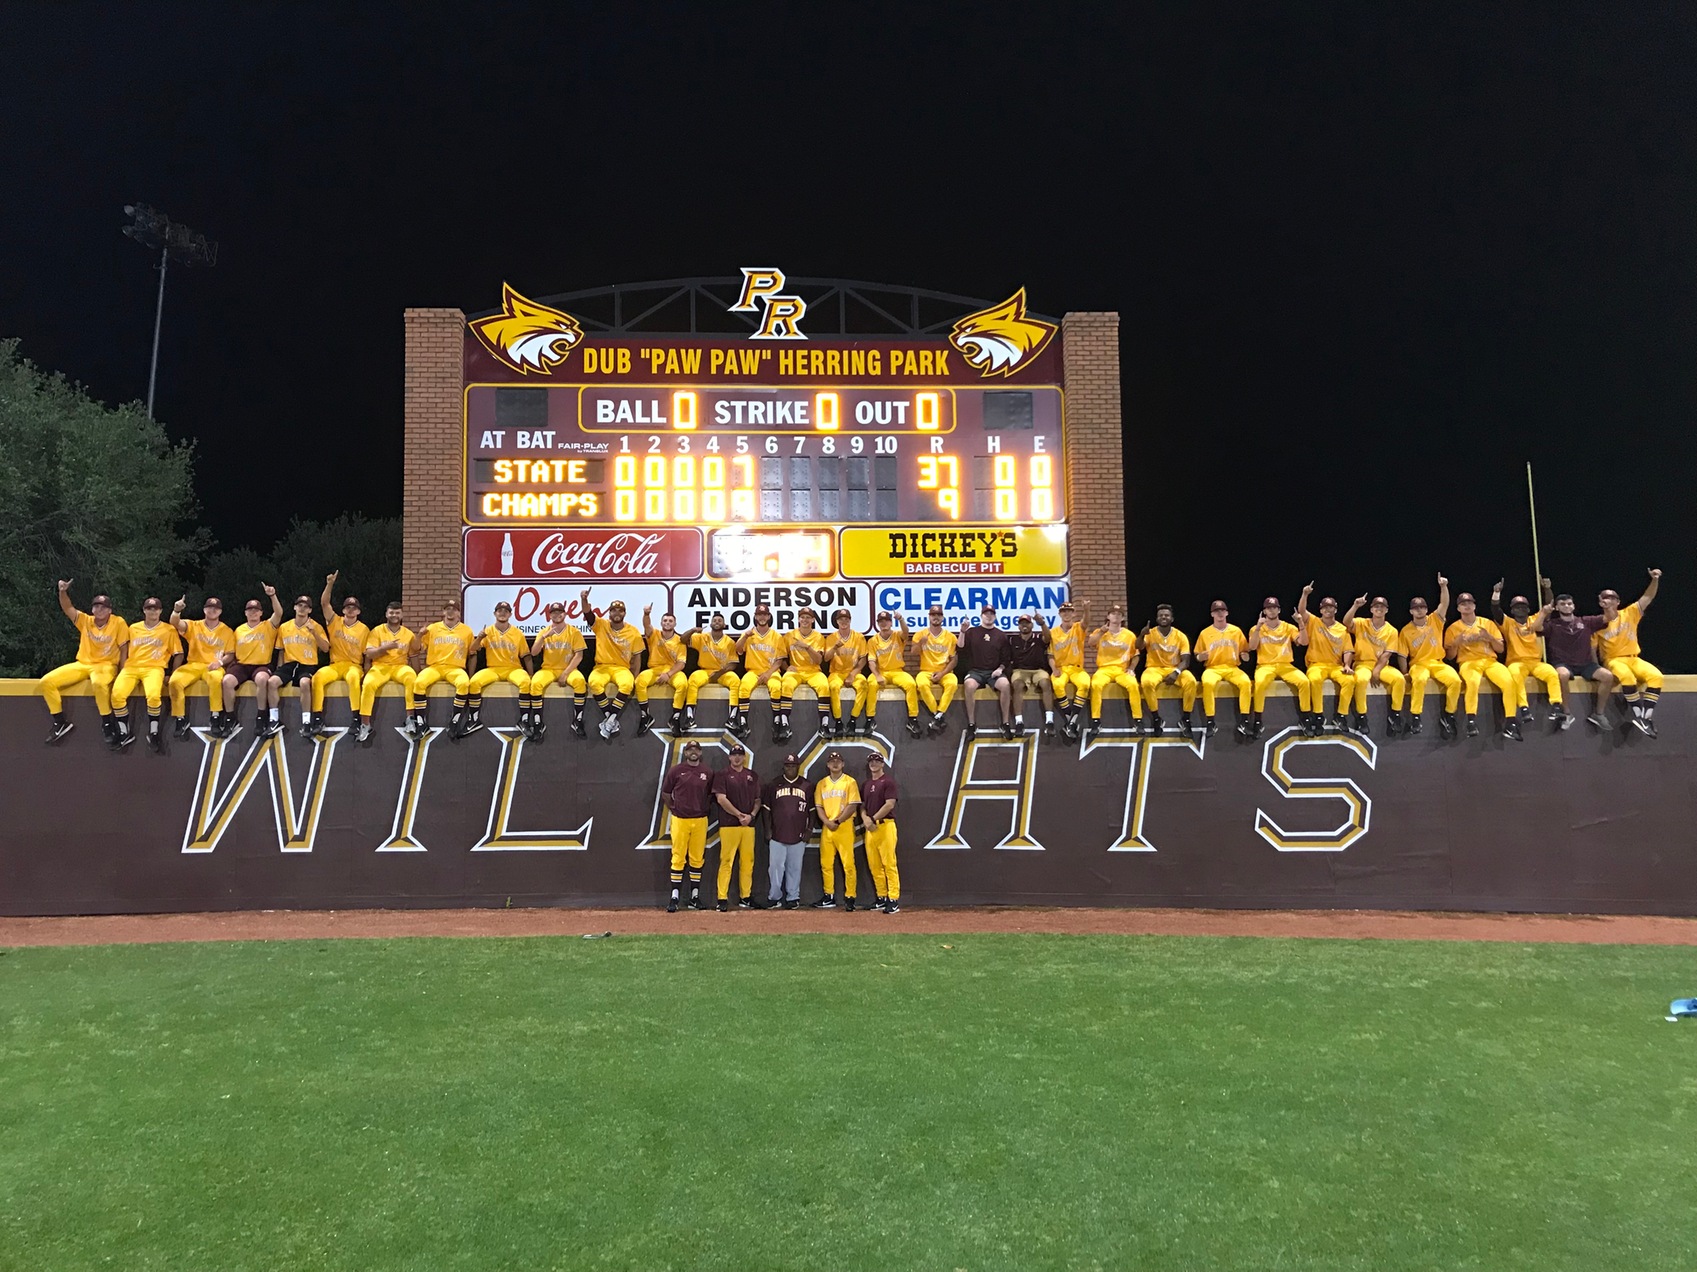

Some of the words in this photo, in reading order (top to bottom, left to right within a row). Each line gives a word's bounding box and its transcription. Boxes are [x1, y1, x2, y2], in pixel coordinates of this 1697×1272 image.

[583, 347, 631, 374] DUB
[641, 347, 702, 374] "PAW
[710, 348, 771, 375] PAW"
[779, 349, 881, 375] HERRING
[890, 350, 950, 376] PARK
[596, 399, 667, 423] BALL
[672, 391, 697, 429] 0
[714, 400, 810, 424] STRIKE
[815, 392, 839, 430] 0
[855, 400, 910, 425] OUT
[915, 392, 939, 430] 0
[479, 430, 505, 449] AT
[516, 430, 556, 449] BAT
[620, 435, 631, 454] 1
[647, 435, 661, 454] 2
[677, 435, 691, 454] 3
[706, 436, 720, 454] 4
[736, 436, 749, 454] 5
[764, 436, 778, 454] 6
[793, 436, 806, 454] 7
[822, 436, 836, 454] 8
[850, 436, 864, 454] 9
[874, 436, 898, 454] 10
[930, 436, 944, 454] R
[987, 435, 1001, 453] H
[1034, 435, 1046, 453] E
[493, 459, 588, 484] STATE
[615, 455, 637, 488] 0
[644, 455, 666, 488] 0
[673, 455, 696, 488] 0
[702, 455, 725, 488] 0
[917, 455, 960, 488] 37
[994, 455, 1016, 488] 0
[1030, 455, 1051, 488] 0
[482, 492, 599, 518] CHAMPS
[615, 489, 637, 521] 0
[644, 489, 666, 521] 0
[673, 489, 696, 521] 0
[702, 489, 726, 521] 0
[938, 488, 960, 520] 9
[995, 488, 1017, 521] 0
[1031, 488, 1052, 521] 0
[531, 532, 667, 575] Coca-Cola
[905, 563, 977, 574] BARBECUE
[981, 563, 1002, 574] PIT
[687, 586, 857, 608] ANDERSON
[879, 586, 1065, 611] CLEARMAN
[798, 801, 808, 812] 37
